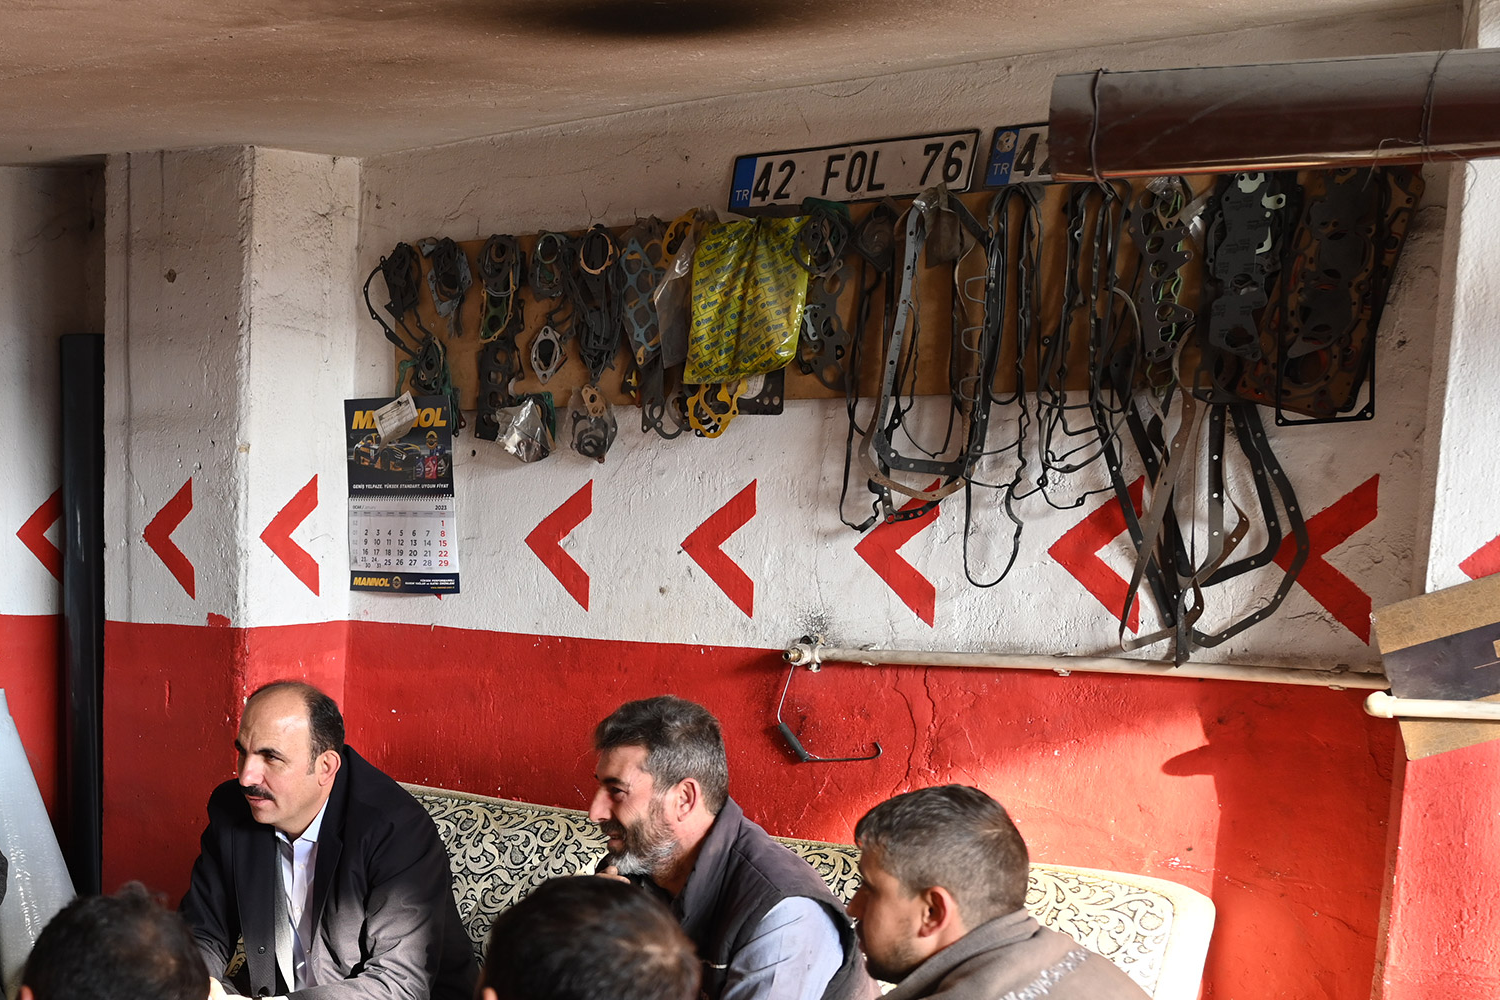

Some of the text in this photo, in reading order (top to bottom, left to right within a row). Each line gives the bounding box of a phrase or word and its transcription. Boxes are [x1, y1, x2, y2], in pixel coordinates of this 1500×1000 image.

[753, 141, 967, 201] 42 FOL 76
[993, 163, 1009, 176] TR
[735, 189, 750, 201] TR
[408, 549, 418, 557] 20
[438, 550, 449, 558] 22
[353, 576, 390, 587] MANNOL
